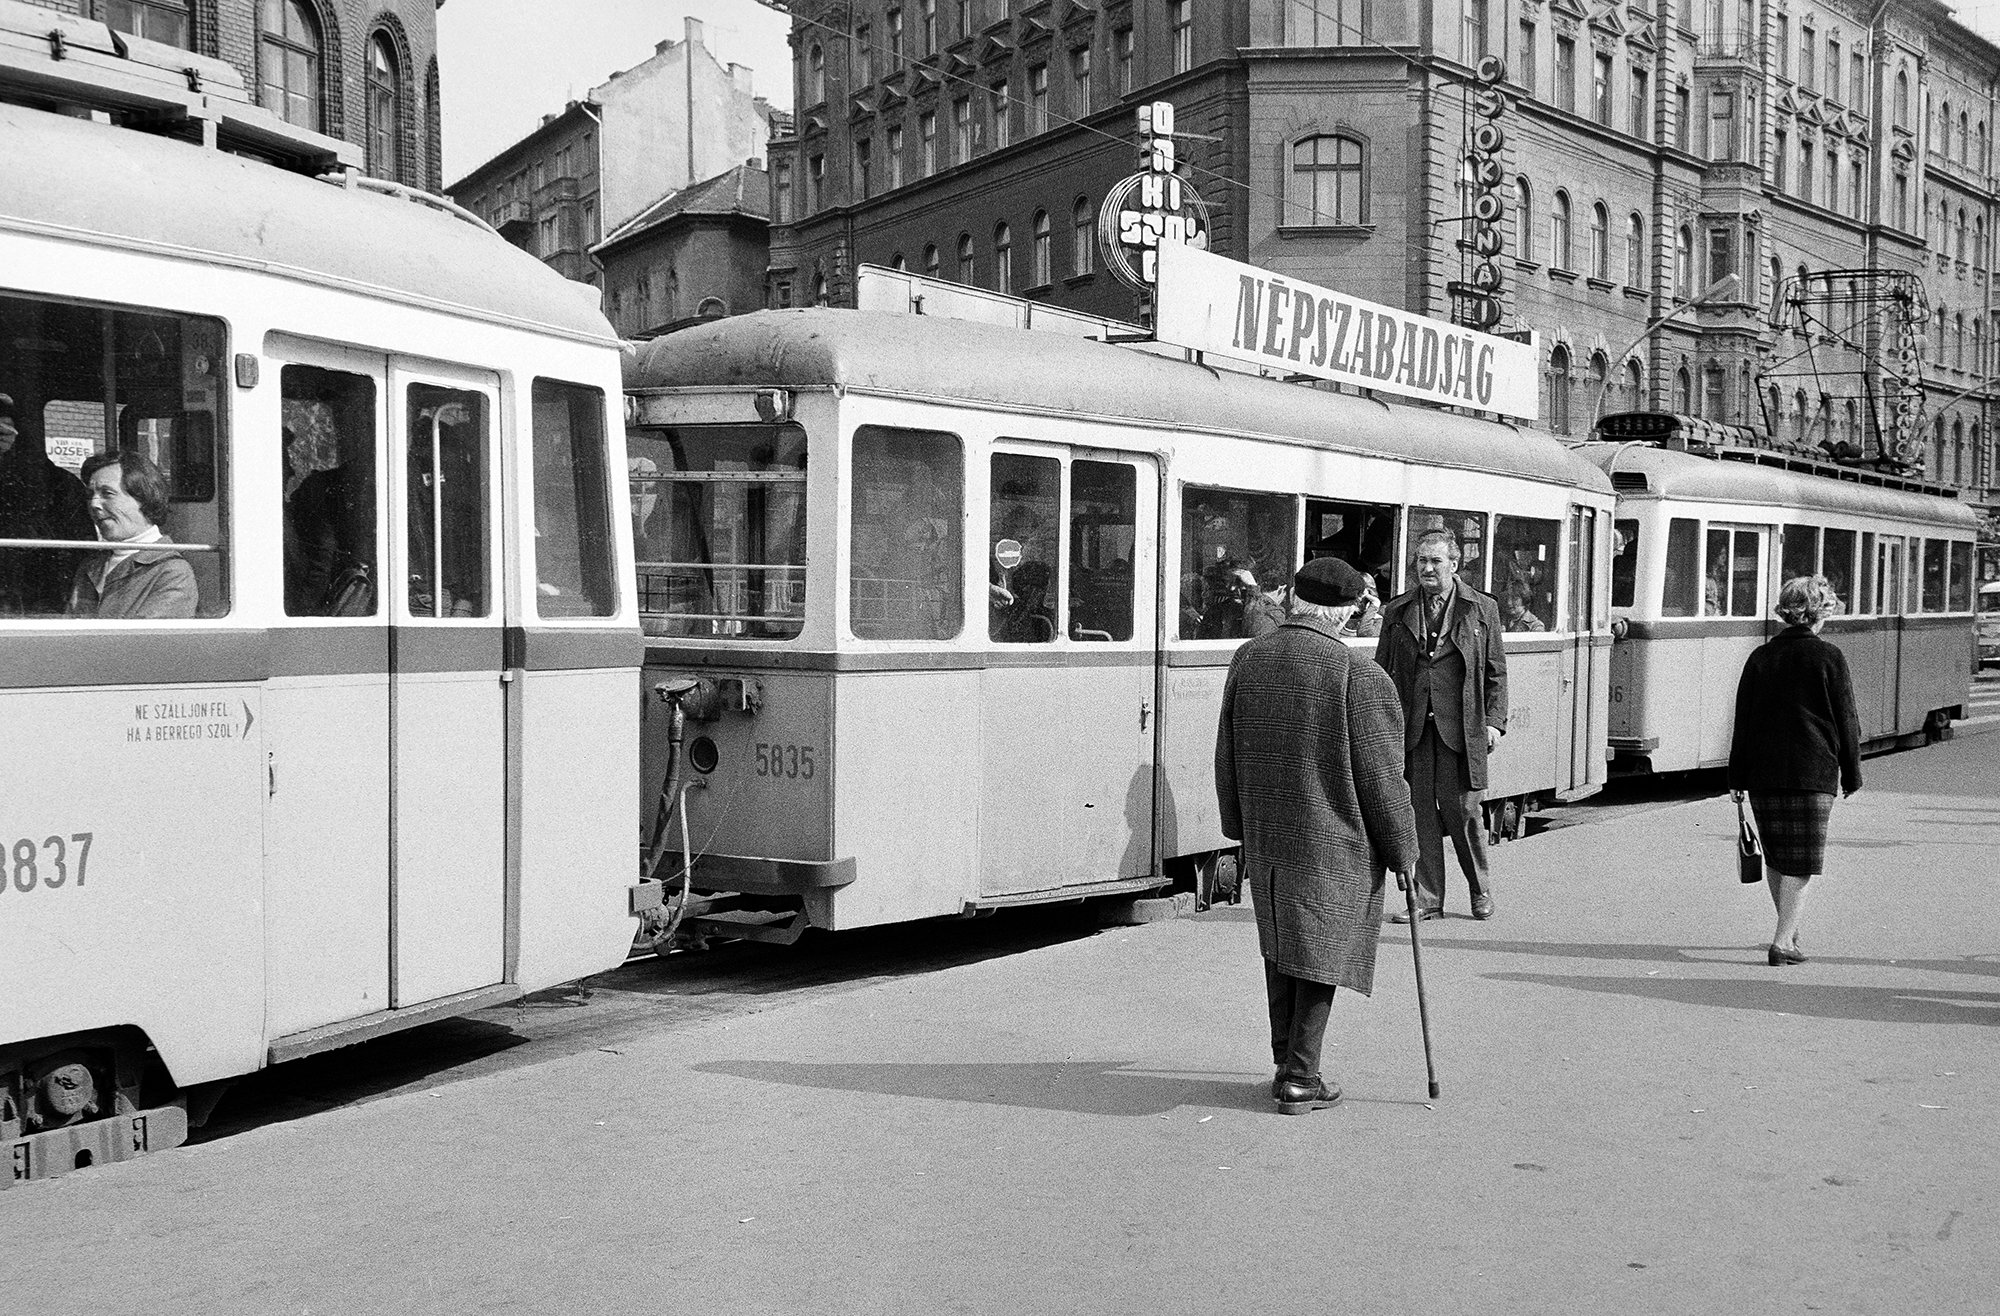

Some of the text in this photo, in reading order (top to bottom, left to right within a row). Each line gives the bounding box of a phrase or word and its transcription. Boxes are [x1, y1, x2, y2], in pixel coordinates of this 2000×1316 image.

[1473, 55, 1503, 328] CSOKONAI
[1232, 274, 1495, 406] NÉPSZABADSÁG
[135, 705, 149, 720] NE
[127, 728, 141, 742] HA
[145, 727, 152, 741] A
[755, 743, 815, 780] 5835
